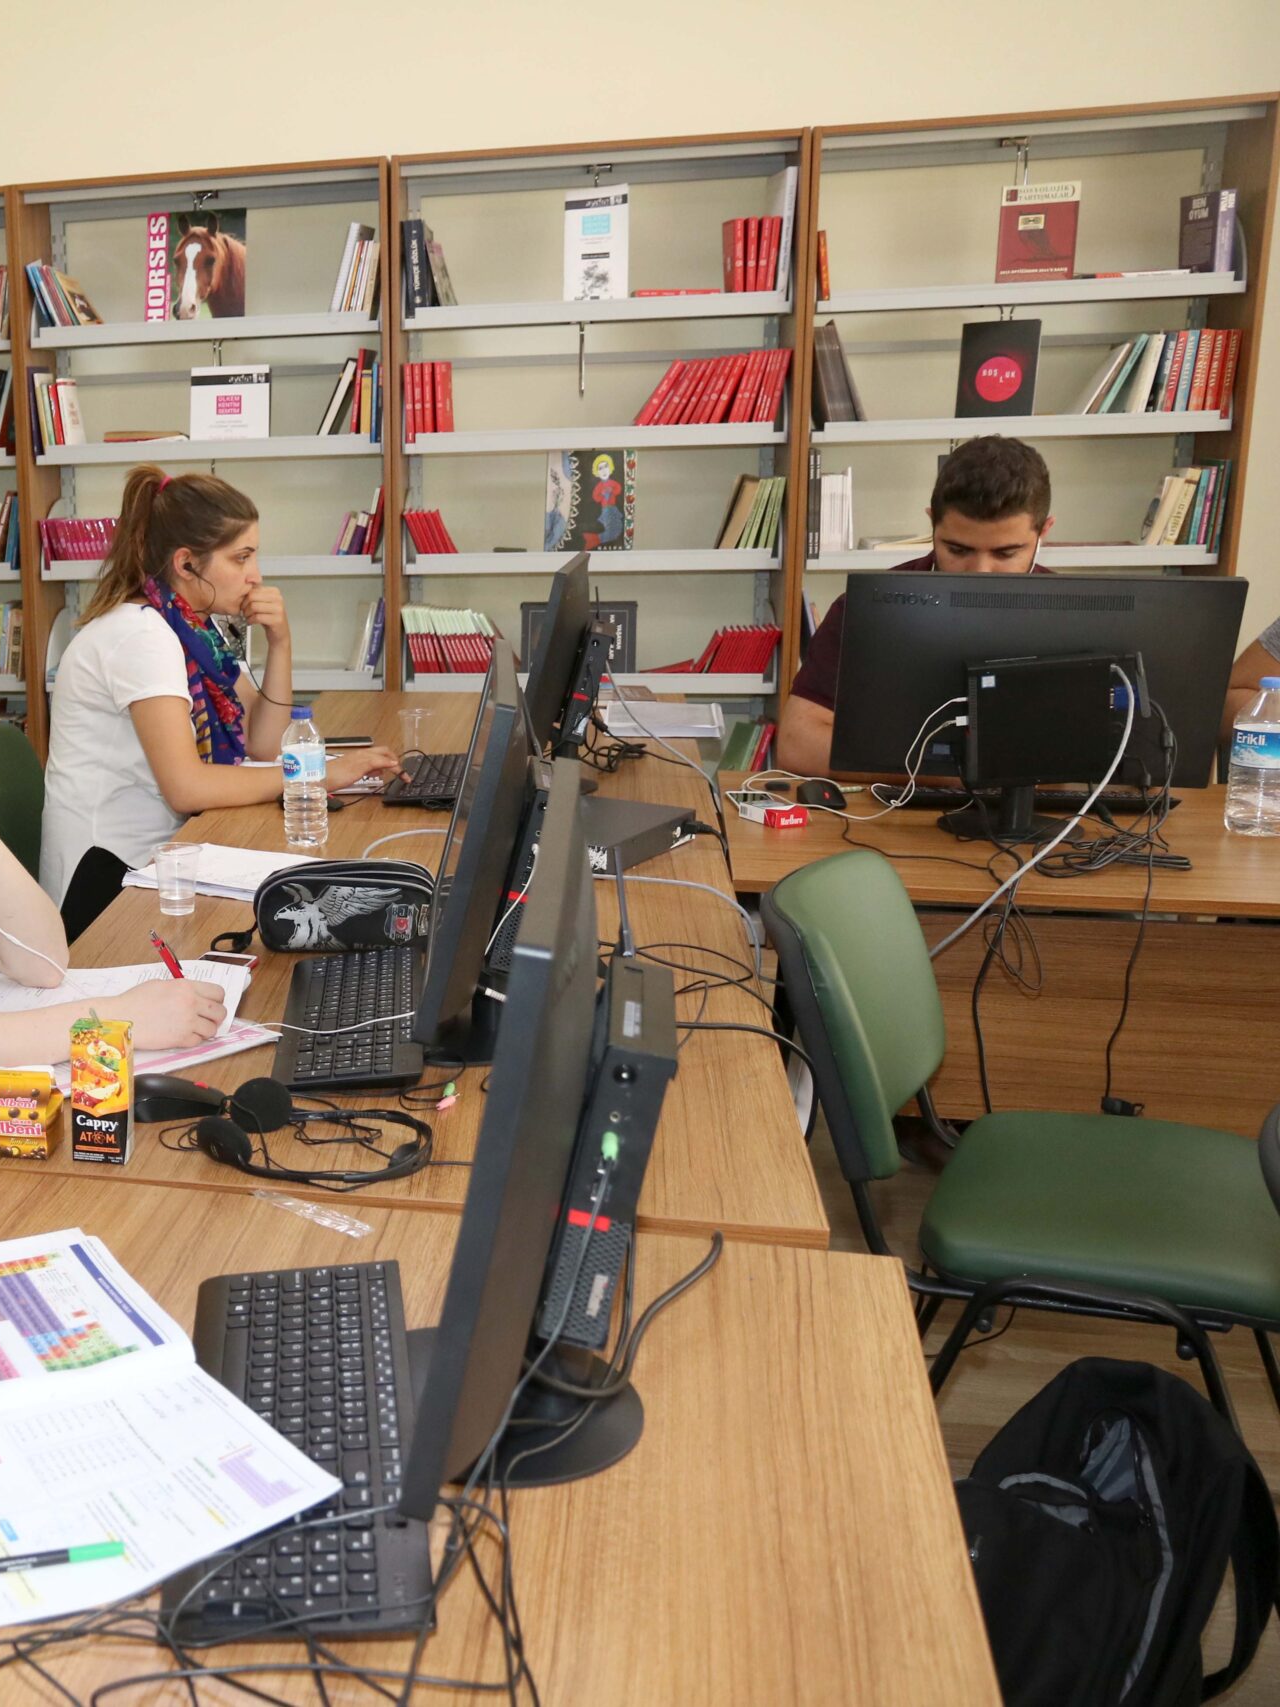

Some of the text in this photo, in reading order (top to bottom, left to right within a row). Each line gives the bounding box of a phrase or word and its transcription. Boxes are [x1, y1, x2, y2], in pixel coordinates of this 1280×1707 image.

[148, 216, 167, 322] HORSES
[873, 588, 940, 606] Lenovo
[1236, 732, 1266, 746] Erikli
[780, 814, 803, 826] Marlboro
[76, 1115, 117, 1131] Cappy
